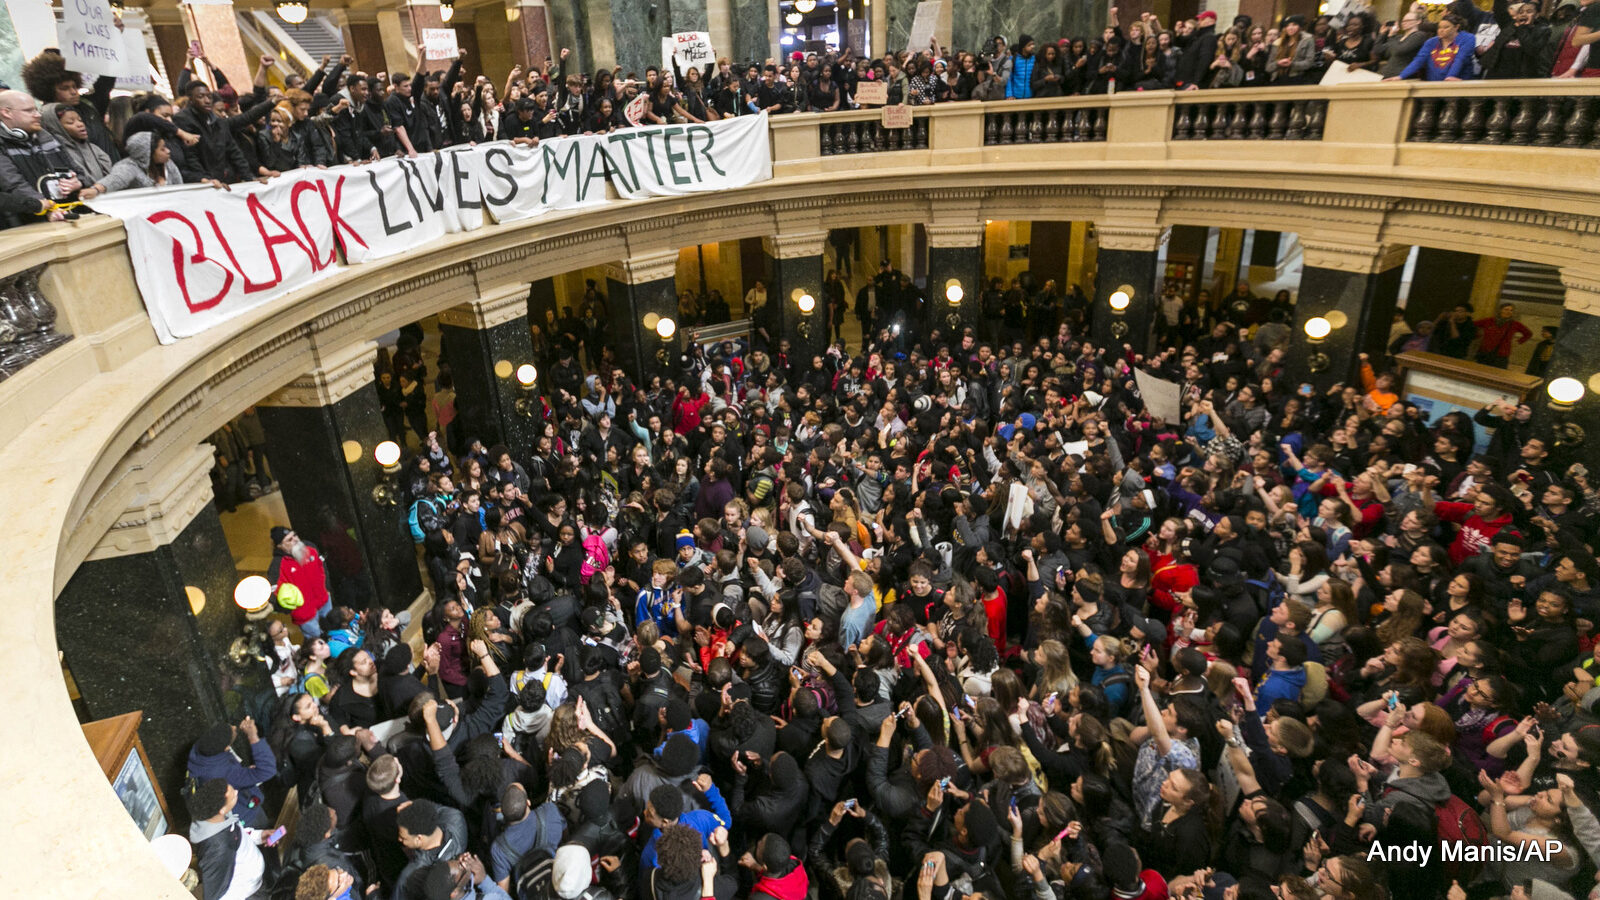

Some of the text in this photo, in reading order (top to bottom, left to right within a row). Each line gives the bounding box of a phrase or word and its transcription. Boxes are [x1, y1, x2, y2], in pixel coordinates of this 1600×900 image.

[84, 22, 112, 40] LIVES
[72, 40, 120, 62] MATTER
[146, 125, 727, 314] BLACK LIVES MATTER
